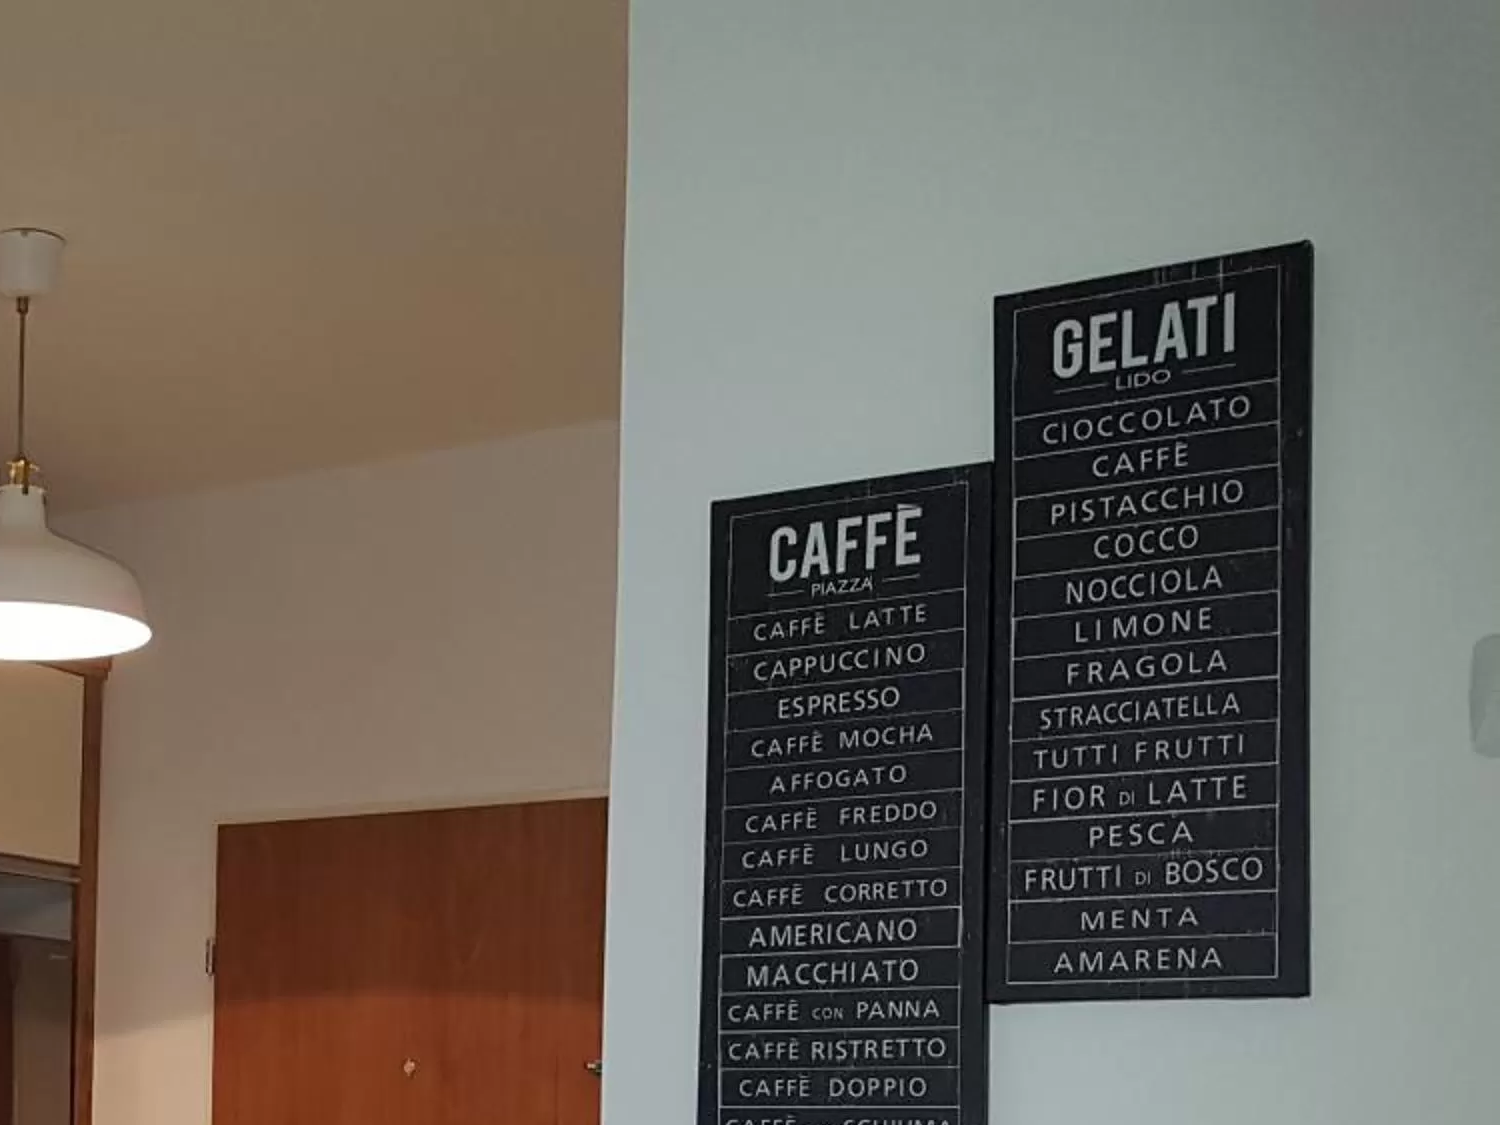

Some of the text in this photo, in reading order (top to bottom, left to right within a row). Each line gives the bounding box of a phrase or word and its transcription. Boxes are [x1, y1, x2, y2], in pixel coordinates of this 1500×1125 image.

[1053, 292, 1236, 379] GELATI
[1115, 369, 1171, 391] LIDO
[1043, 395, 1251, 445] CIOCCOLATO
[1051, 480, 1243, 526] PISTACCHIO
[1094, 525, 1199, 559] COCCO
[811, 578, 873, 597] PIAZZA
[1066, 565, 1223, 604] NOCCIOLA
[850, 604, 927, 629] LATTE
[1075, 608, 1212, 643] LIMONE
[753, 643, 925, 681] CAPPUCCINO
[1067, 649, 1228, 685] FRAGOLA
[778, 686, 900, 719] ESPRESSO
[1040, 692, 1240, 730] STRACCIATELLA
[839, 724, 933, 749] MOCHA
[1033, 734, 1244, 769] TUTTI FRUTTI
[770, 764, 907, 794] AFFOGATO
[1033, 776, 1246, 812] FIOR DI LATTE
[839, 801, 937, 826] FREDDO
[1089, 821, 1193, 849] PESCA
[841, 840, 928, 862] LUNGO
[1025, 857, 1263, 891] FRUTTI DI BOSCO
[824, 879, 948, 904] CORRETTO
[749, 918, 917, 948] AMERICANO
[1081, 907, 1198, 931] MENTA
[747, 959, 919, 987] MACCHIATO
[1054, 948, 1222, 973] AMARENA
[812, 1007, 843, 1020] CON
[856, 1000, 940, 1020] PANNA
[811, 1038, 945, 1061] RISTRETTO
[829, 1077, 926, 1098] DOPPIO
